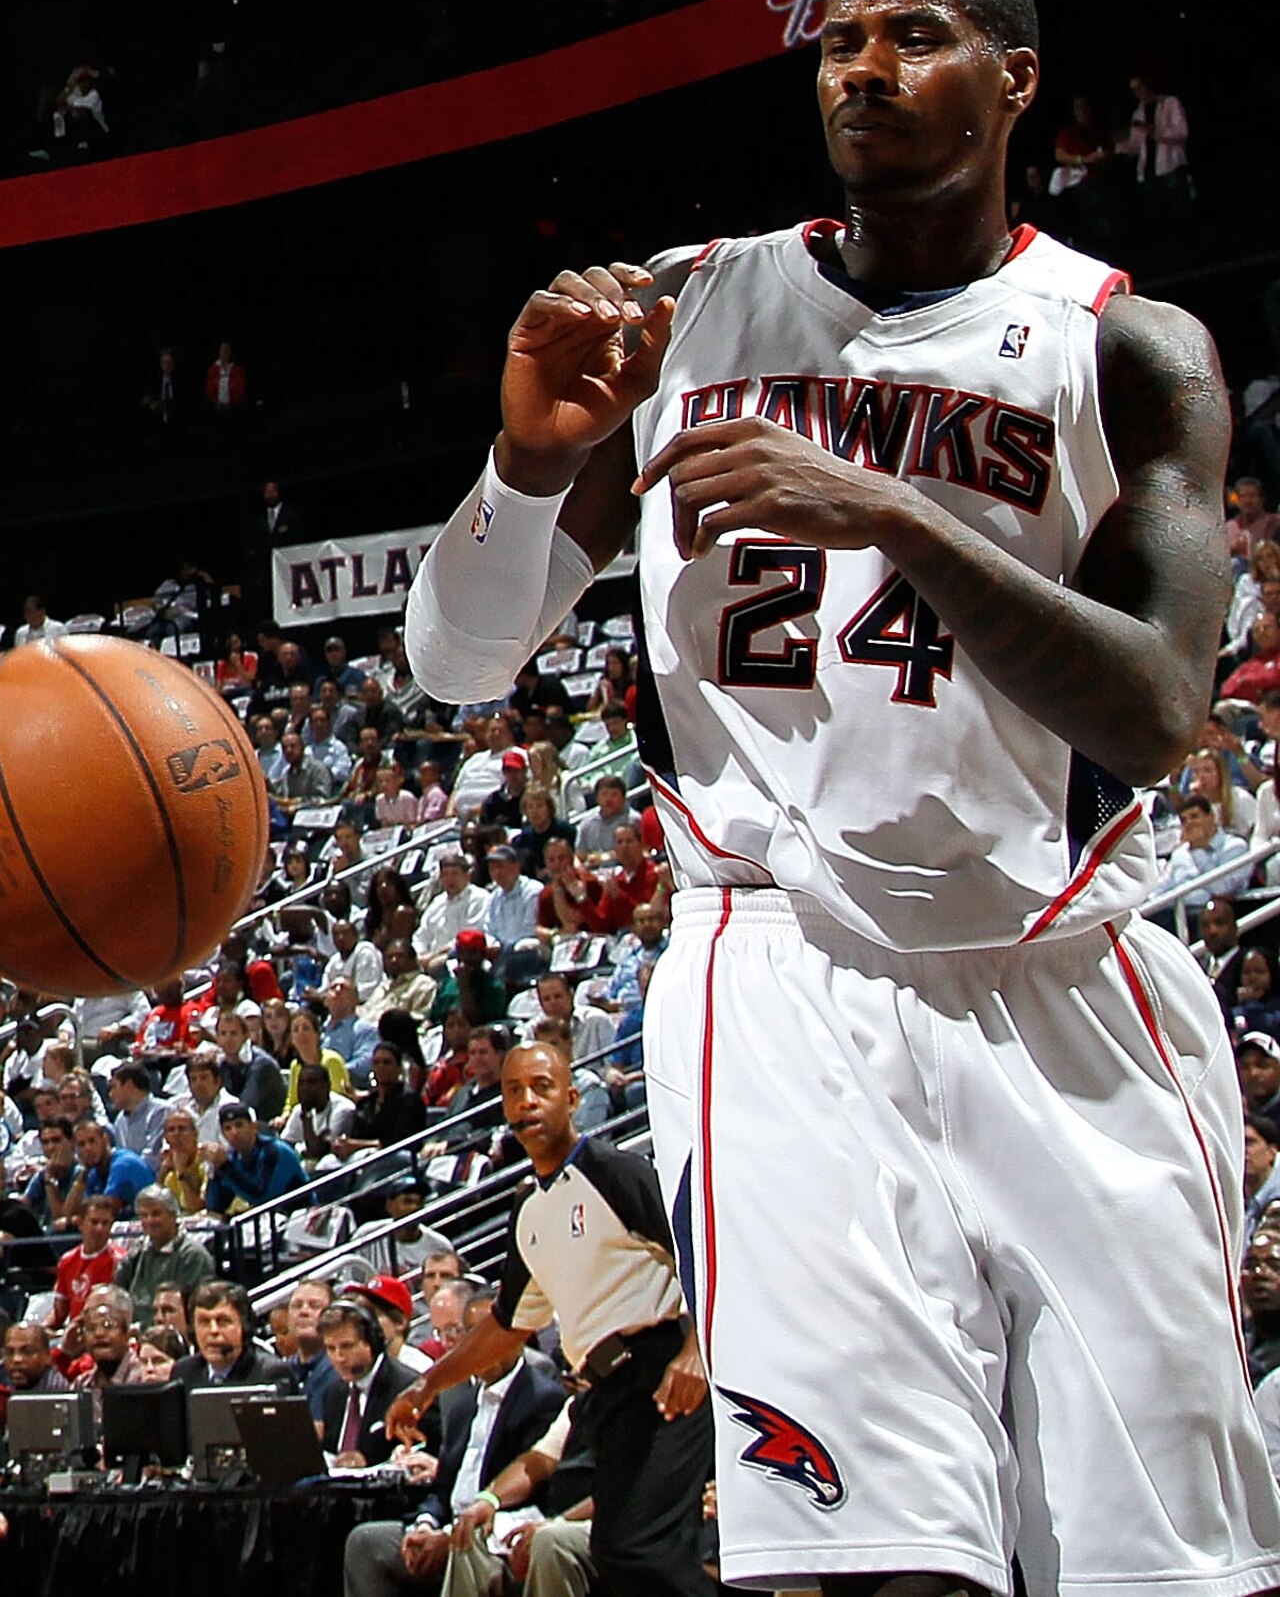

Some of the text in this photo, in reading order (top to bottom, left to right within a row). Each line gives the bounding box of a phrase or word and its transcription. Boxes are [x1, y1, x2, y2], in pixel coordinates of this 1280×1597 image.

[681, 376, 1055, 516] HAWKS
[289, 544, 431, 608] ATLA
[718, 538, 955, 708] 24
